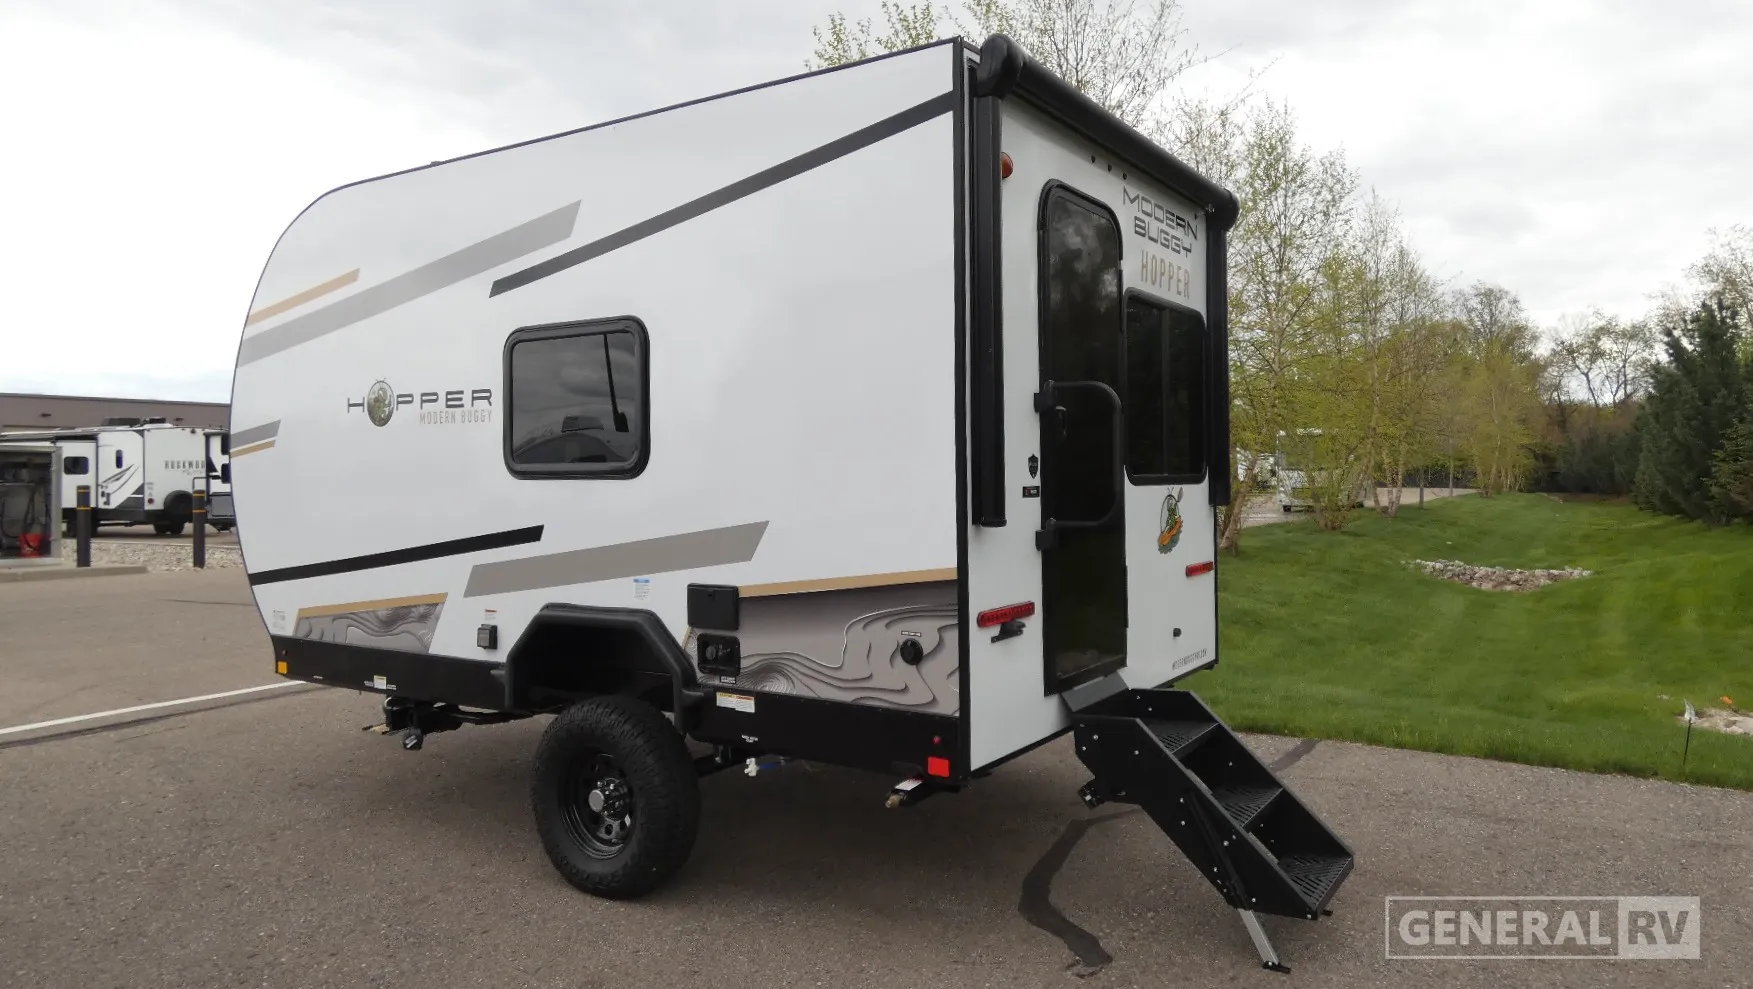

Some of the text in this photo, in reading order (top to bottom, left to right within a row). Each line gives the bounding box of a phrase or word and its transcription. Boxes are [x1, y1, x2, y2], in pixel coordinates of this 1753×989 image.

[1122, 185, 1198, 241] MODERN
[1134, 215, 1192, 258] BUGGY
[1140, 249, 1190, 299] HOPPER
[347, 380, 492, 427] HOPPER
[419, 409, 492, 425] MODERN BUGGY
